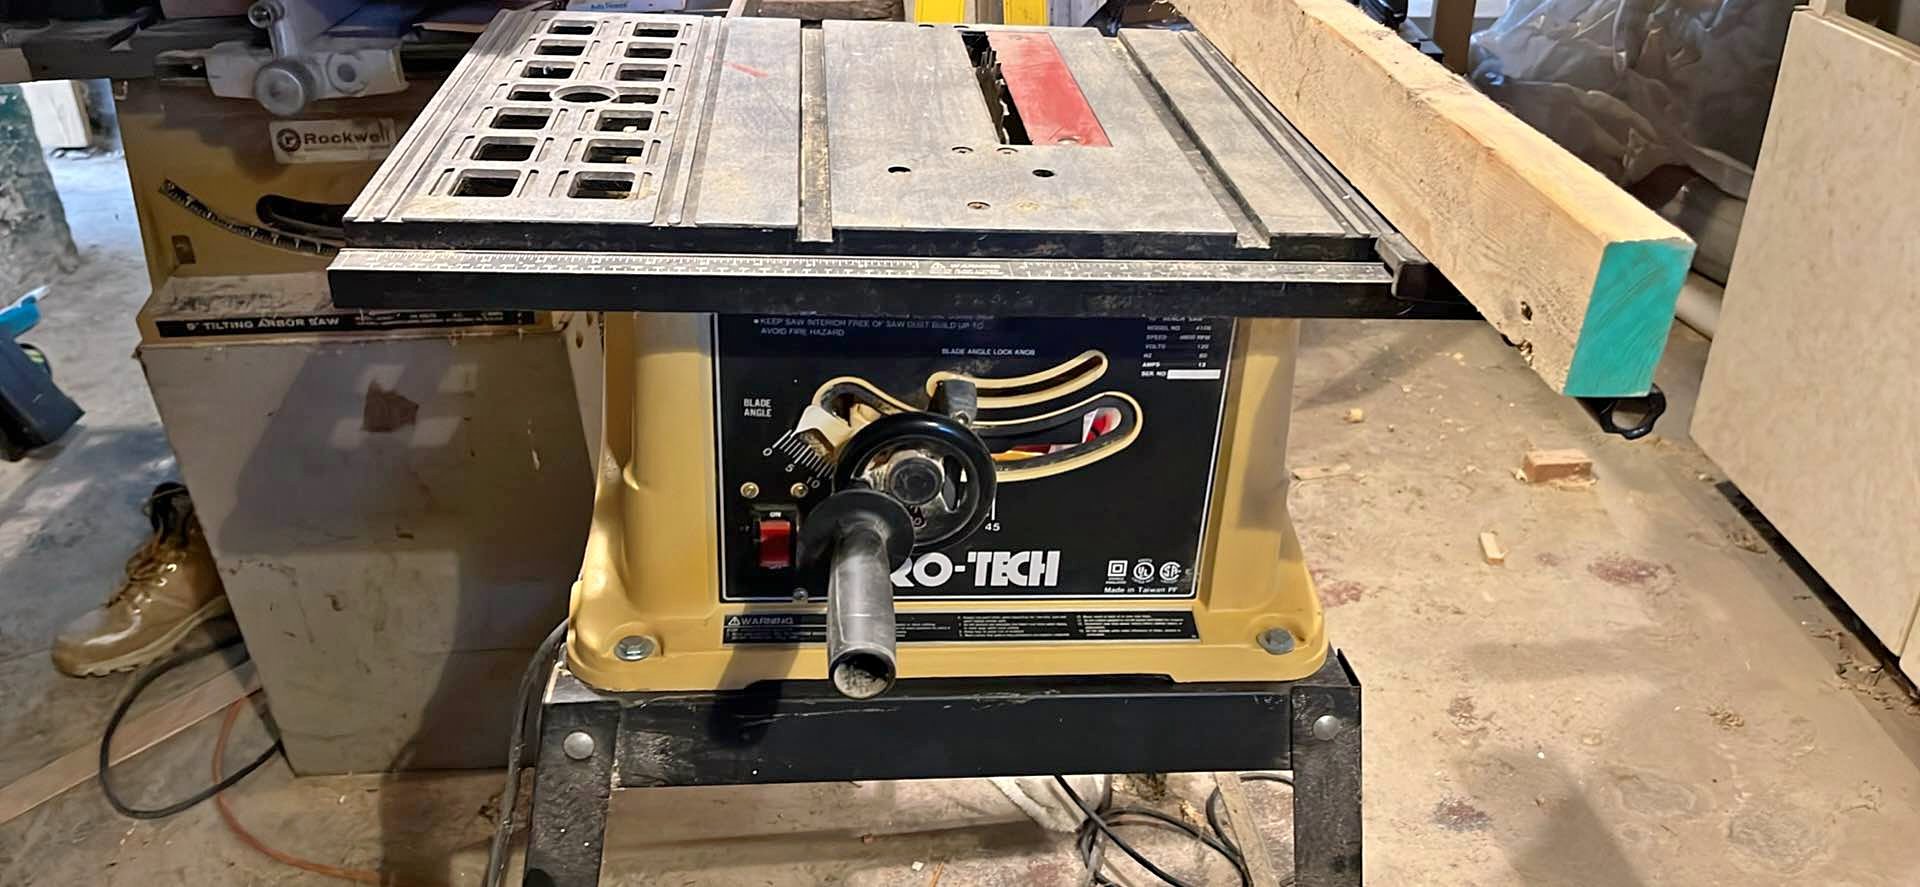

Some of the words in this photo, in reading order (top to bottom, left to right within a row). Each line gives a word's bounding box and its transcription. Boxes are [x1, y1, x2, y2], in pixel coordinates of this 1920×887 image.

[203, 320, 254, 330] TILTING
[257, 318, 304, 328] ARBOR
[308, 316, 340, 326] SAW
[760, 318, 784, 326] KEEP
[785, 318, 805, 326] SAW
[807, 319, 846, 327] INTERIOR
[848, 319, 869, 328] FREE
[886, 320, 905, 328] SAW
[907, 320, 930, 328] DUST
[932, 320, 954, 329] BUILD
[957, 321, 970, 329] UP
[972, 321, 985, 330] TO
[761, 327, 788, 335] AVOID
[789, 328, 807, 336] FIRE
[810, 328, 845, 336] HAZARD
[941, 347, 965, 355] BLADE
[967, 347, 991, 356] ANGLE
[993, 348, 1013, 356] LOCK
[1014, 348, 1036, 356] KNOB
[743, 398, 772, 408] BLADE
[743, 408, 773, 418] ANGLE
[762, 447, 773, 457] 0
[784, 463, 795, 473] 5
[984, 522, 1001, 532] 45
[1104, 586, 1125, 594] Made
[740, 616, 794, 625] WARNING
